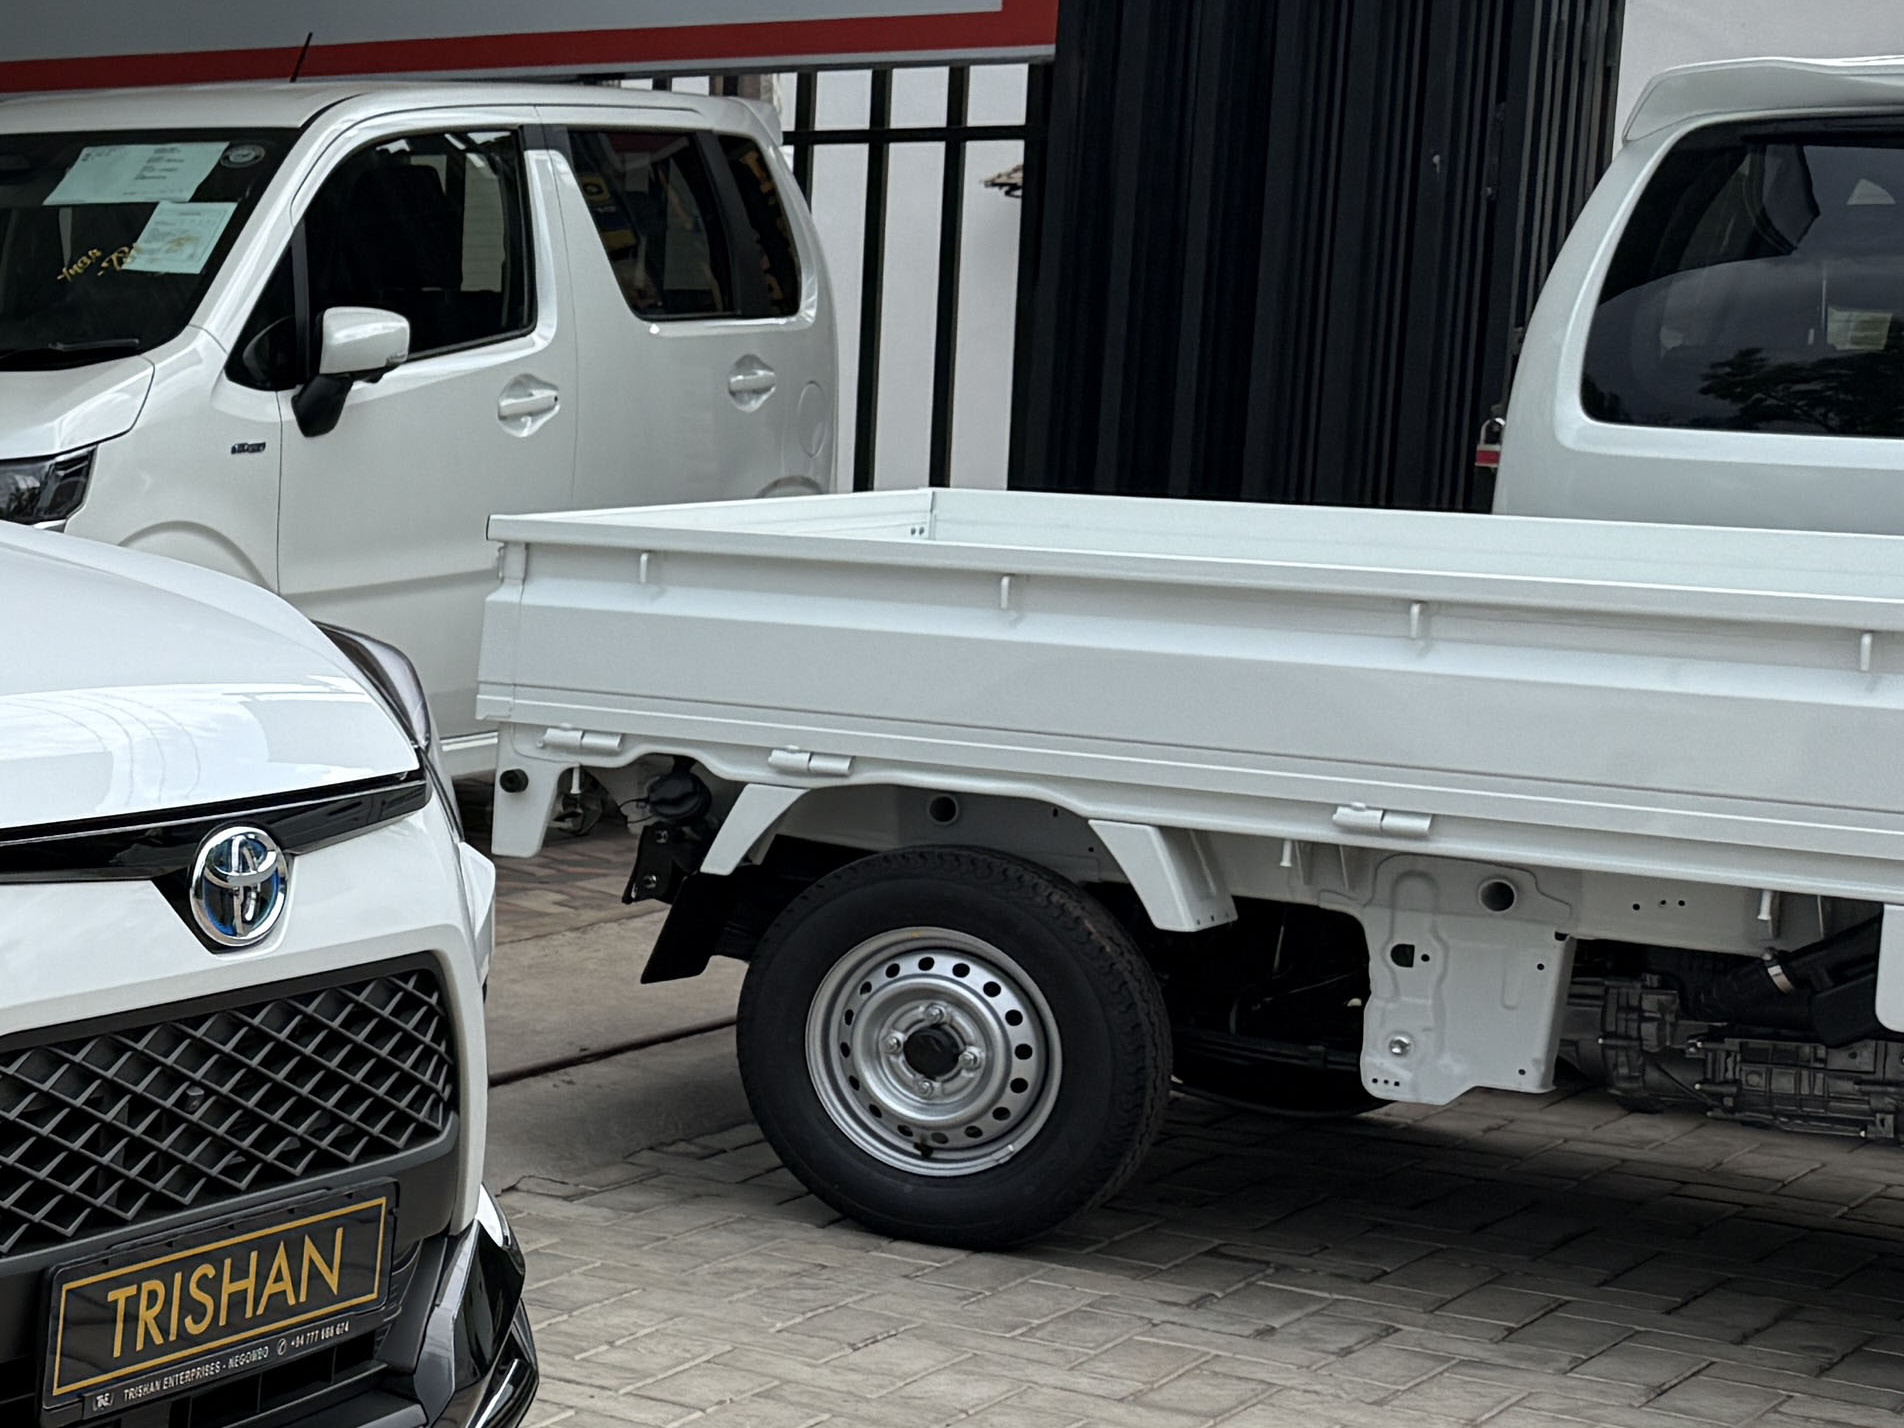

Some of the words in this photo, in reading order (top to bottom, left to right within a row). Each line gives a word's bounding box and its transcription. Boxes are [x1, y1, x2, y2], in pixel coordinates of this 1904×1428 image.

[107, 1227, 344, 1358] TRISHAN
[123, 1379, 161, 1402] TRISHAN
[162, 1361, 222, 1391] ENTERPRISES
[228, 1346, 269, 1372] NEGOMBO
